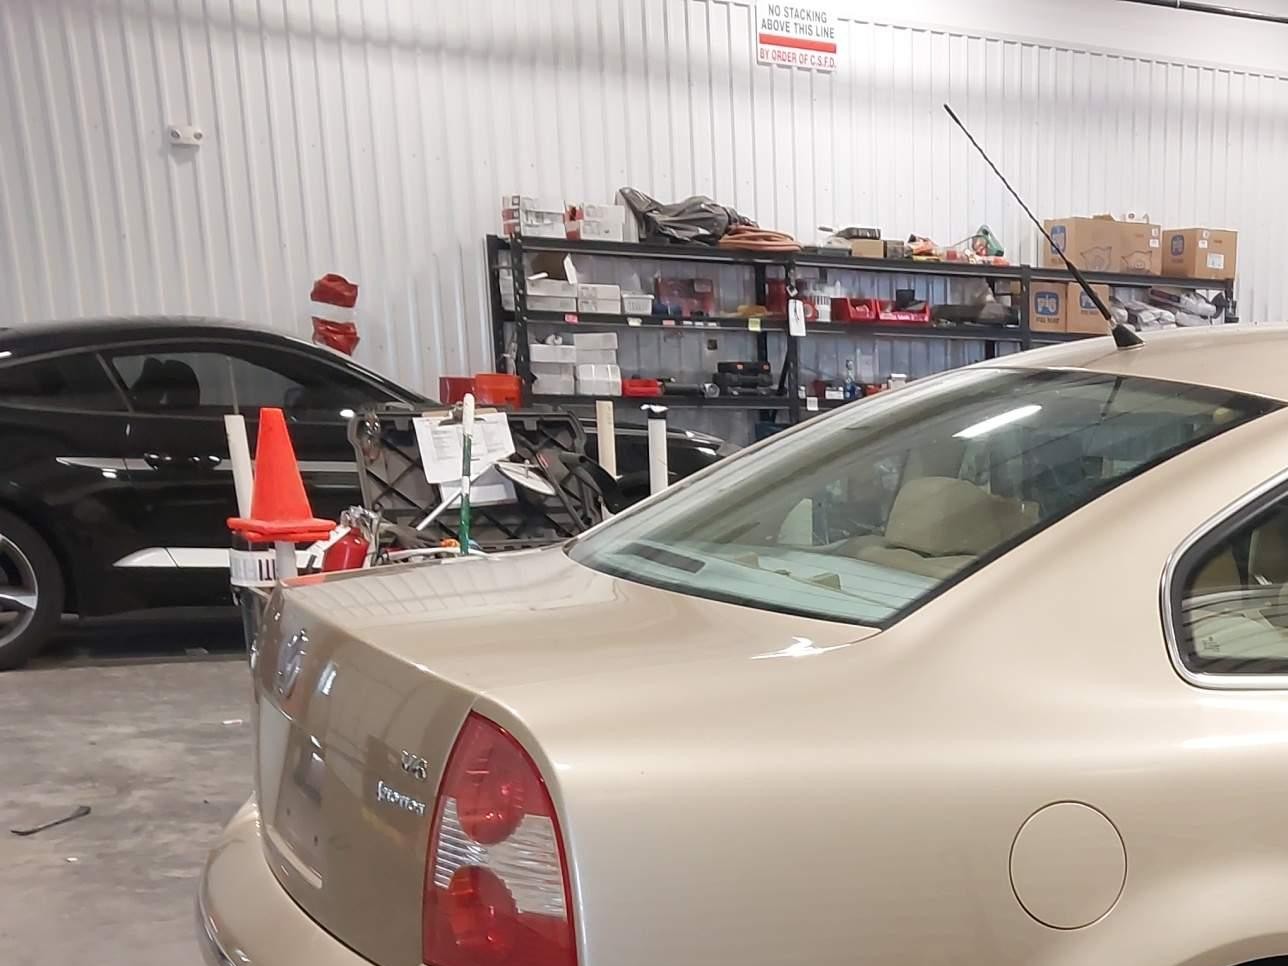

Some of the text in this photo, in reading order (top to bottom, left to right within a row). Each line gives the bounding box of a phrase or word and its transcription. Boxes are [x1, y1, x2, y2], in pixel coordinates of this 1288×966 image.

[768, 4, 827, 24] NO STACKING
[761, 18, 835, 39] ABOVE THIS LINE
[760, 47, 769, 60] BY
[771, 49, 797, 63] ORDER
[799, 53, 810, 65] OF
